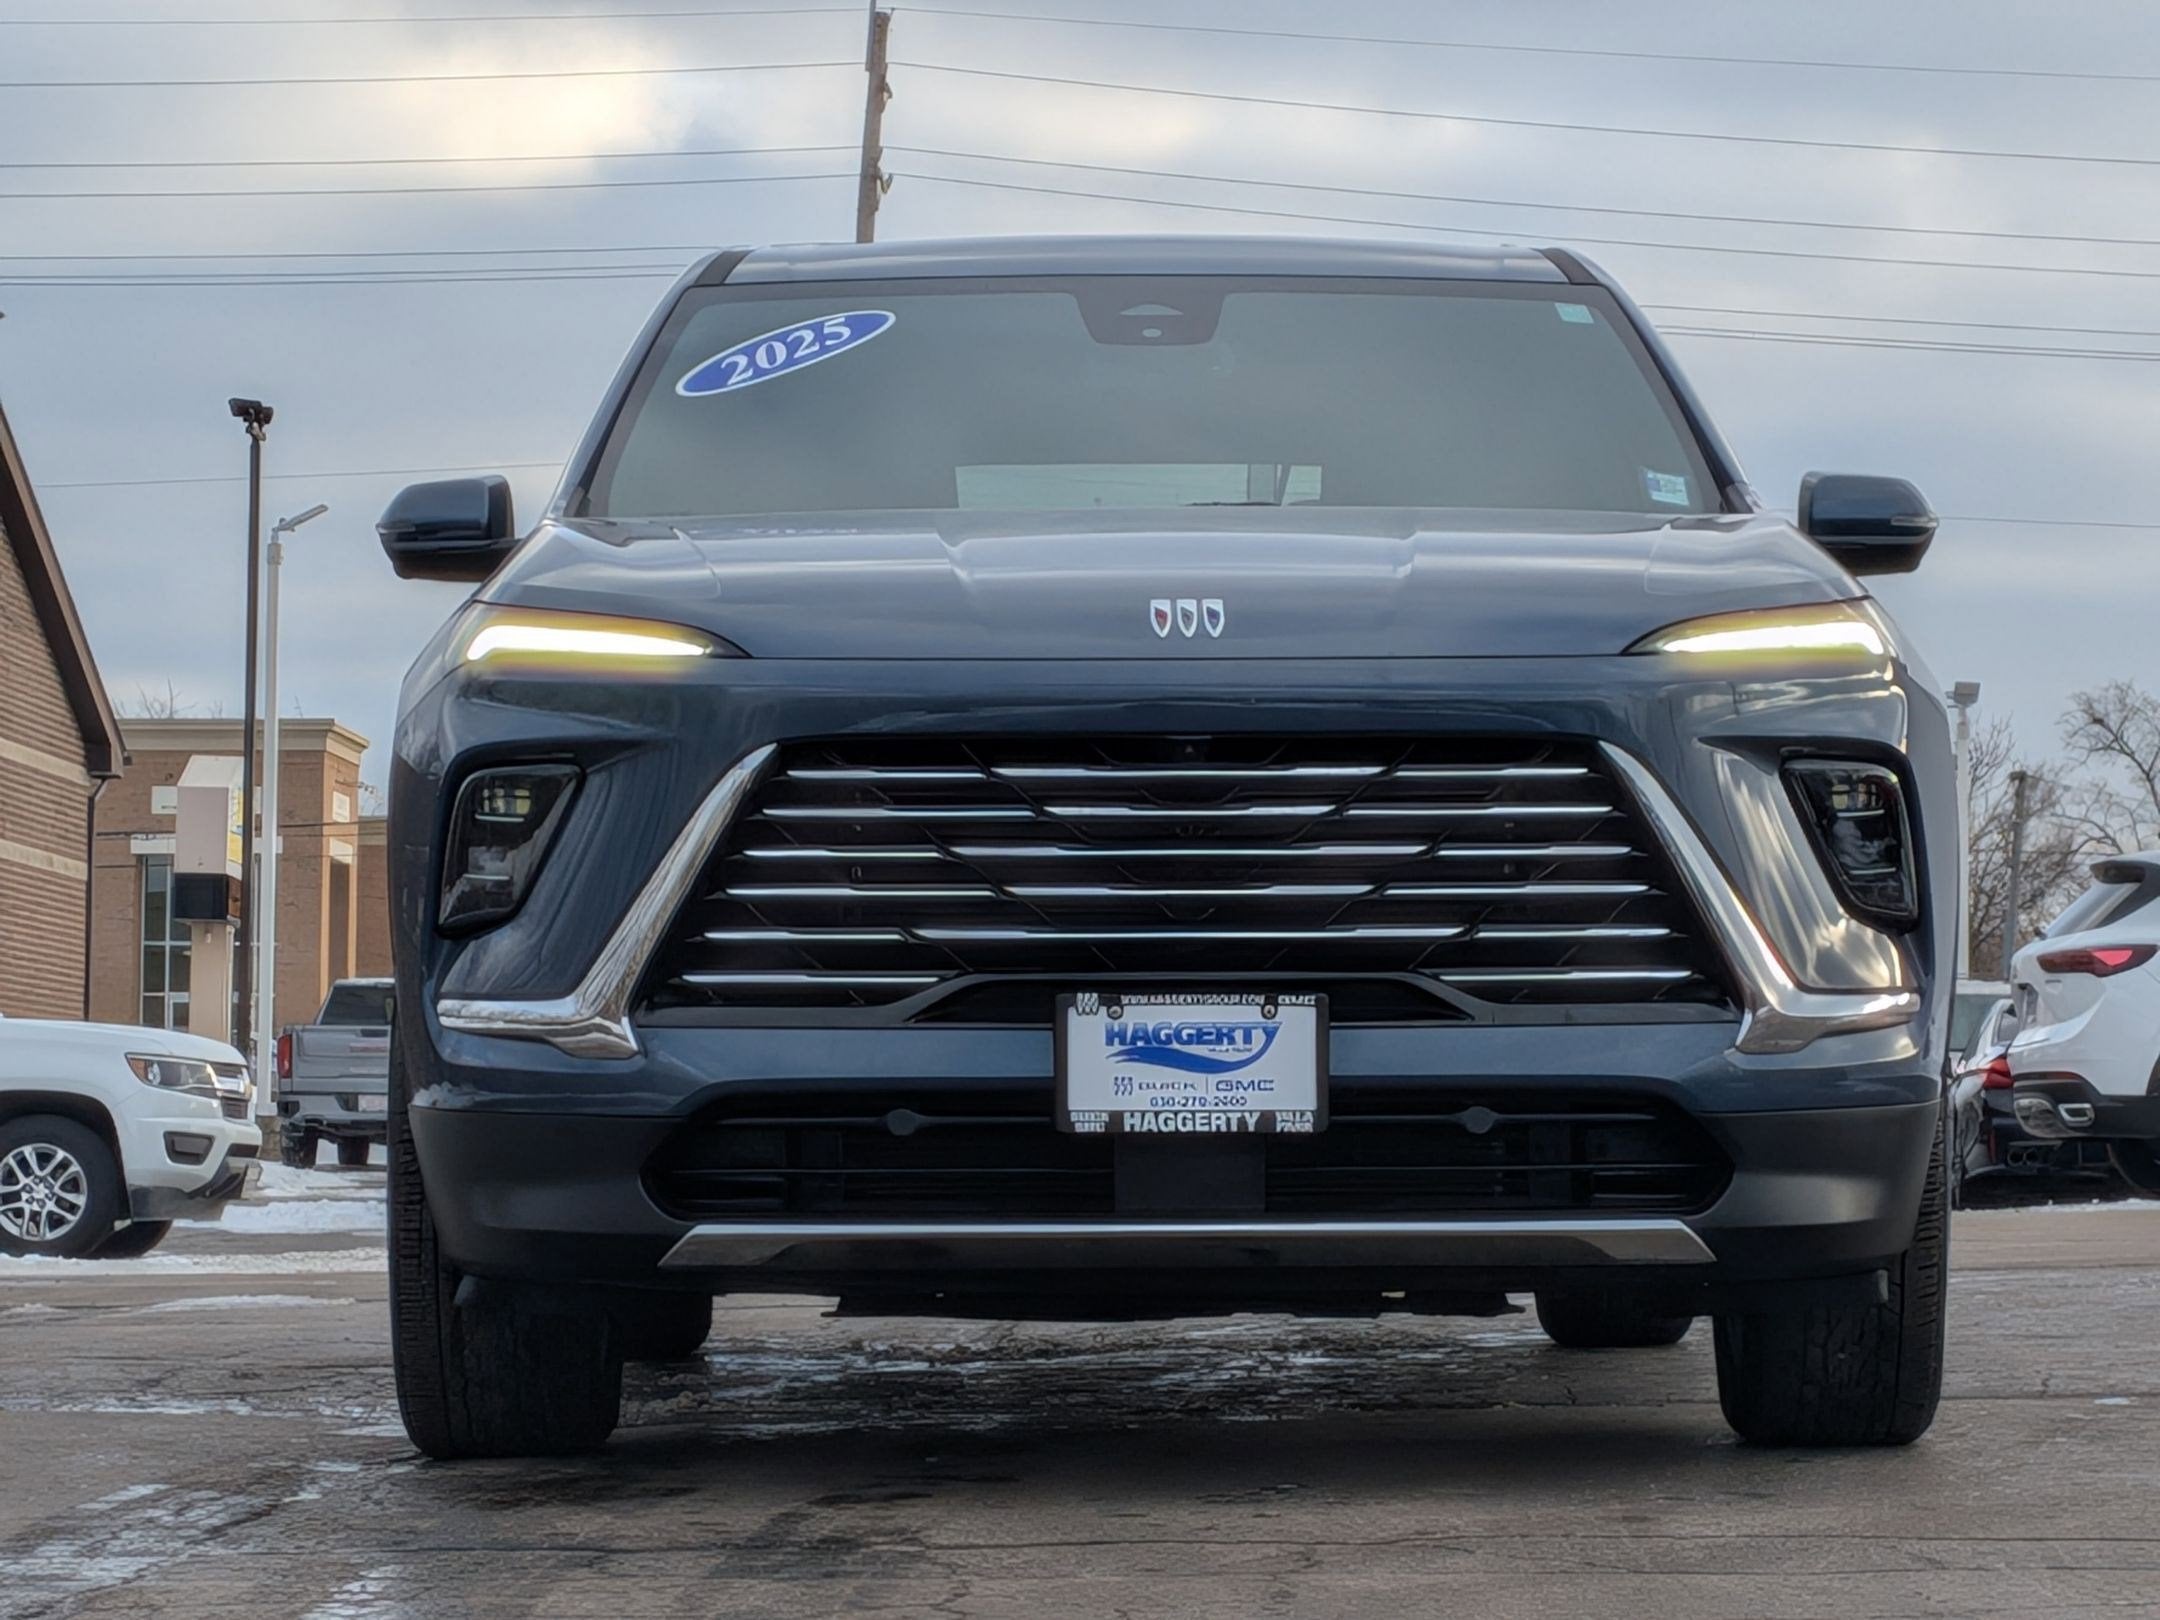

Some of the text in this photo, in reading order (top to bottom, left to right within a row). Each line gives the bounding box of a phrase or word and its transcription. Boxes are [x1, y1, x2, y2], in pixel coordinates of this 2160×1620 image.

[720, 316, 851, 386] 2025
[1105, 1022, 1283, 1047] HAGGERTY
[1215, 1079, 1275, 1092] GMC
[1123, 1112, 1261, 1133] HAGGERTY
